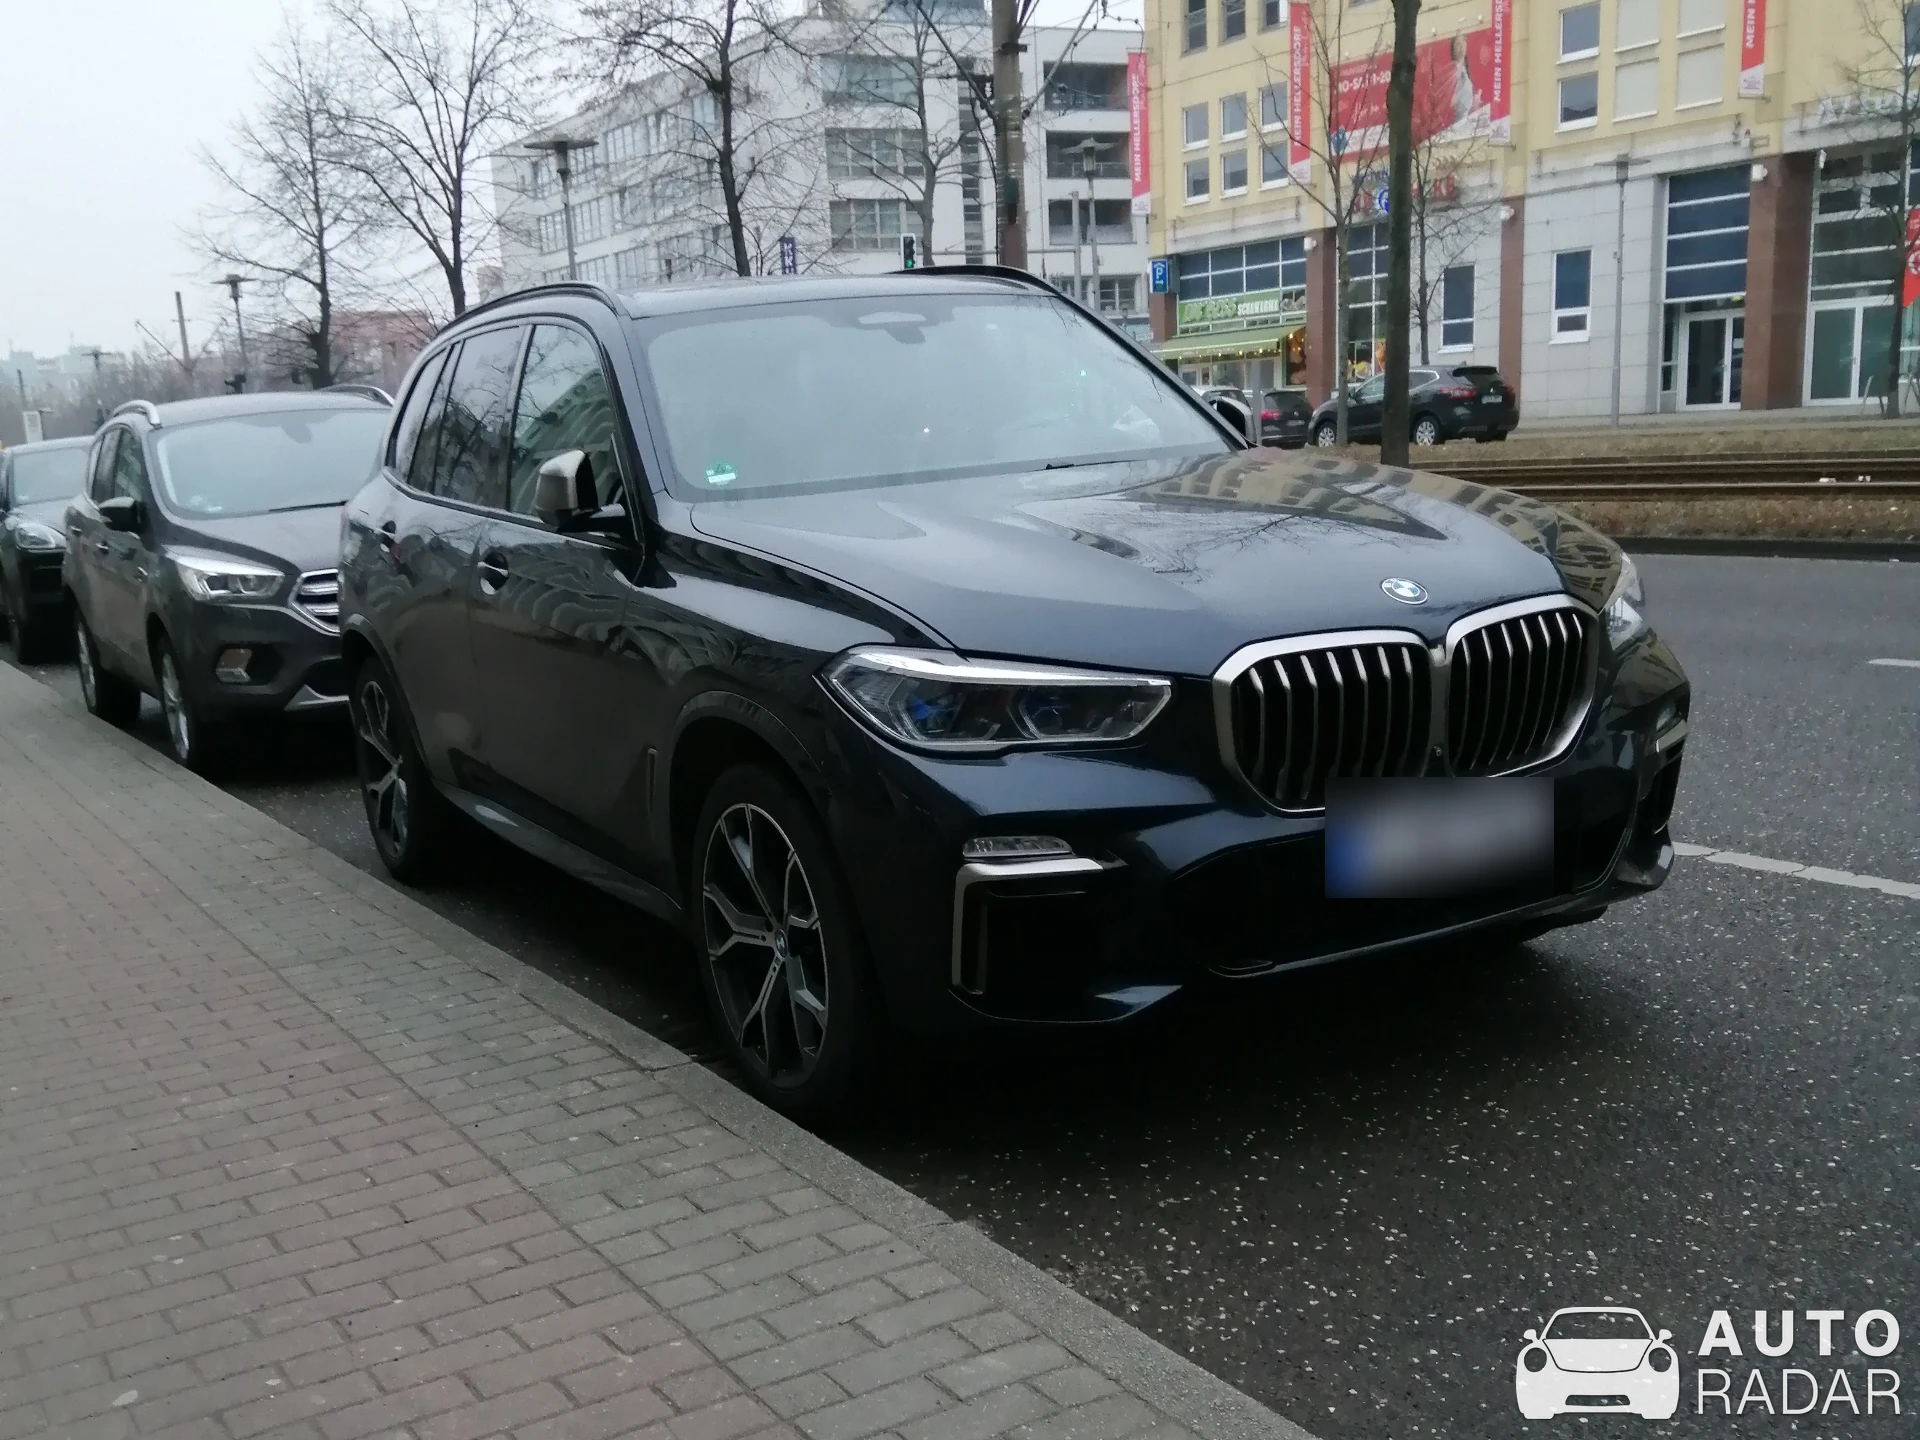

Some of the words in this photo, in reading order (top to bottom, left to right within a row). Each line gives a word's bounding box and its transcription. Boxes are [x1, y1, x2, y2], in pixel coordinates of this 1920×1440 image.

[1745, 8, 1756, 49] MEIN
[1293, 25, 1302, 114] HELLERSDORF
[1493, 66, 1502, 102] MEIN
[1131, 73, 1141, 152] HELLERSDORF
[1132, 153, 1142, 183] MEIN
